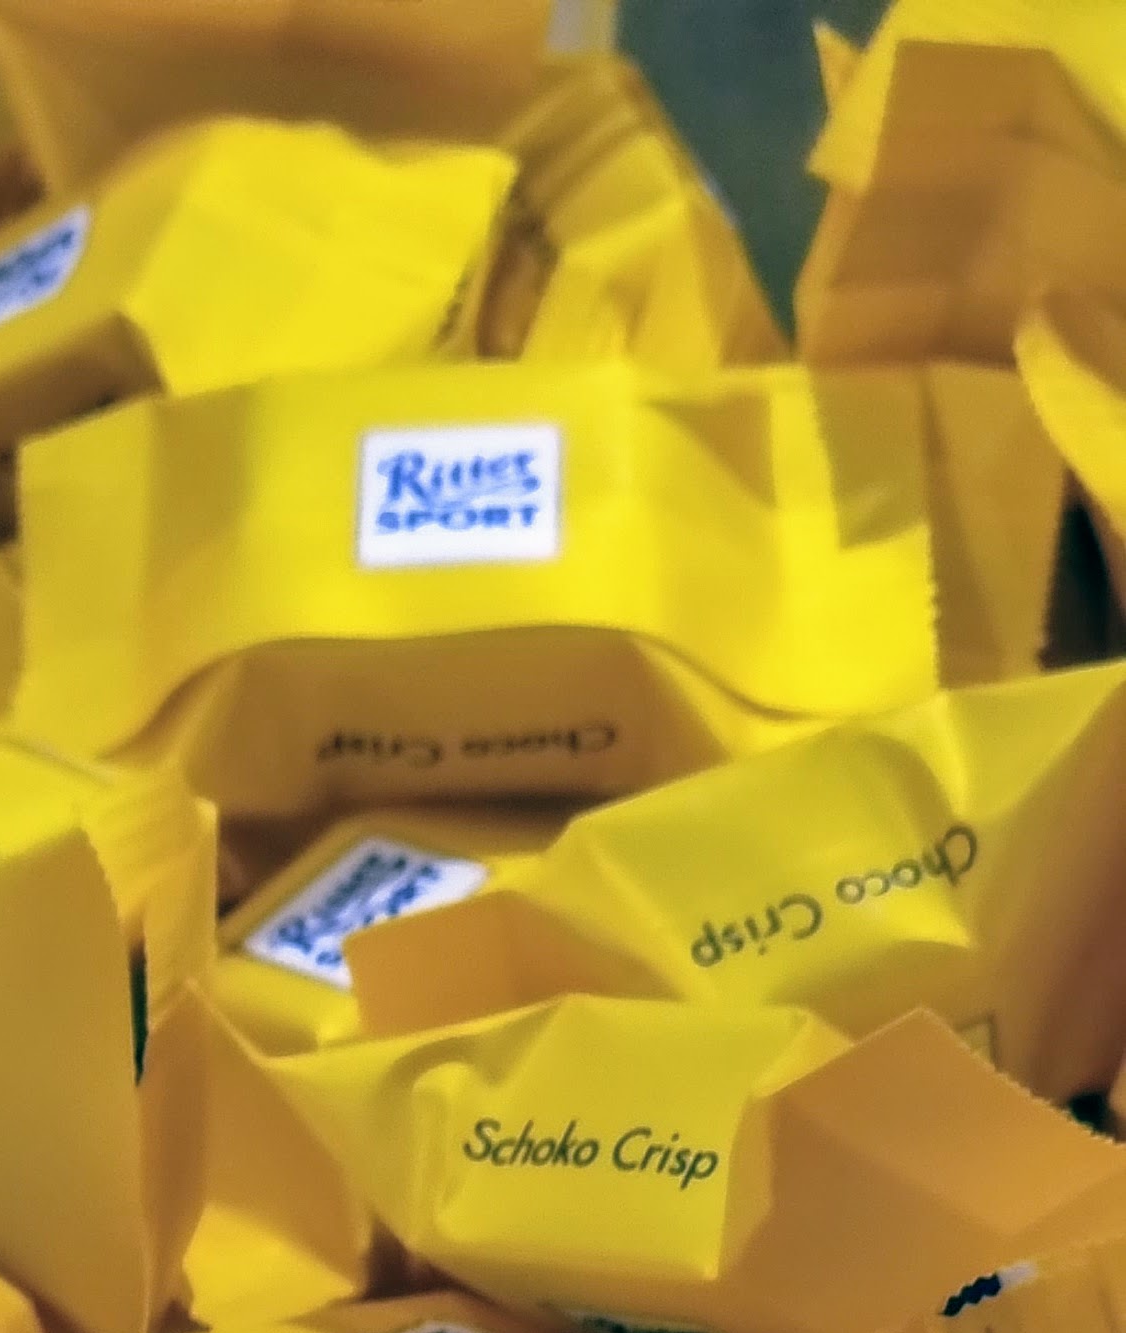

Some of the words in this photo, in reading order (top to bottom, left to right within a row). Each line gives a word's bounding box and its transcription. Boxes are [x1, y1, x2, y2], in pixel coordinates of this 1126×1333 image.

[376, 447, 541, 508] Ritter
[376, 503, 539, 535] SPORT
[834, 825, 979, 906] Choco
[689, 890, 824, 968] Crisp
[463, 1118, 600, 1170] Schoko
[612, 1126, 719, 1190] Crisp
